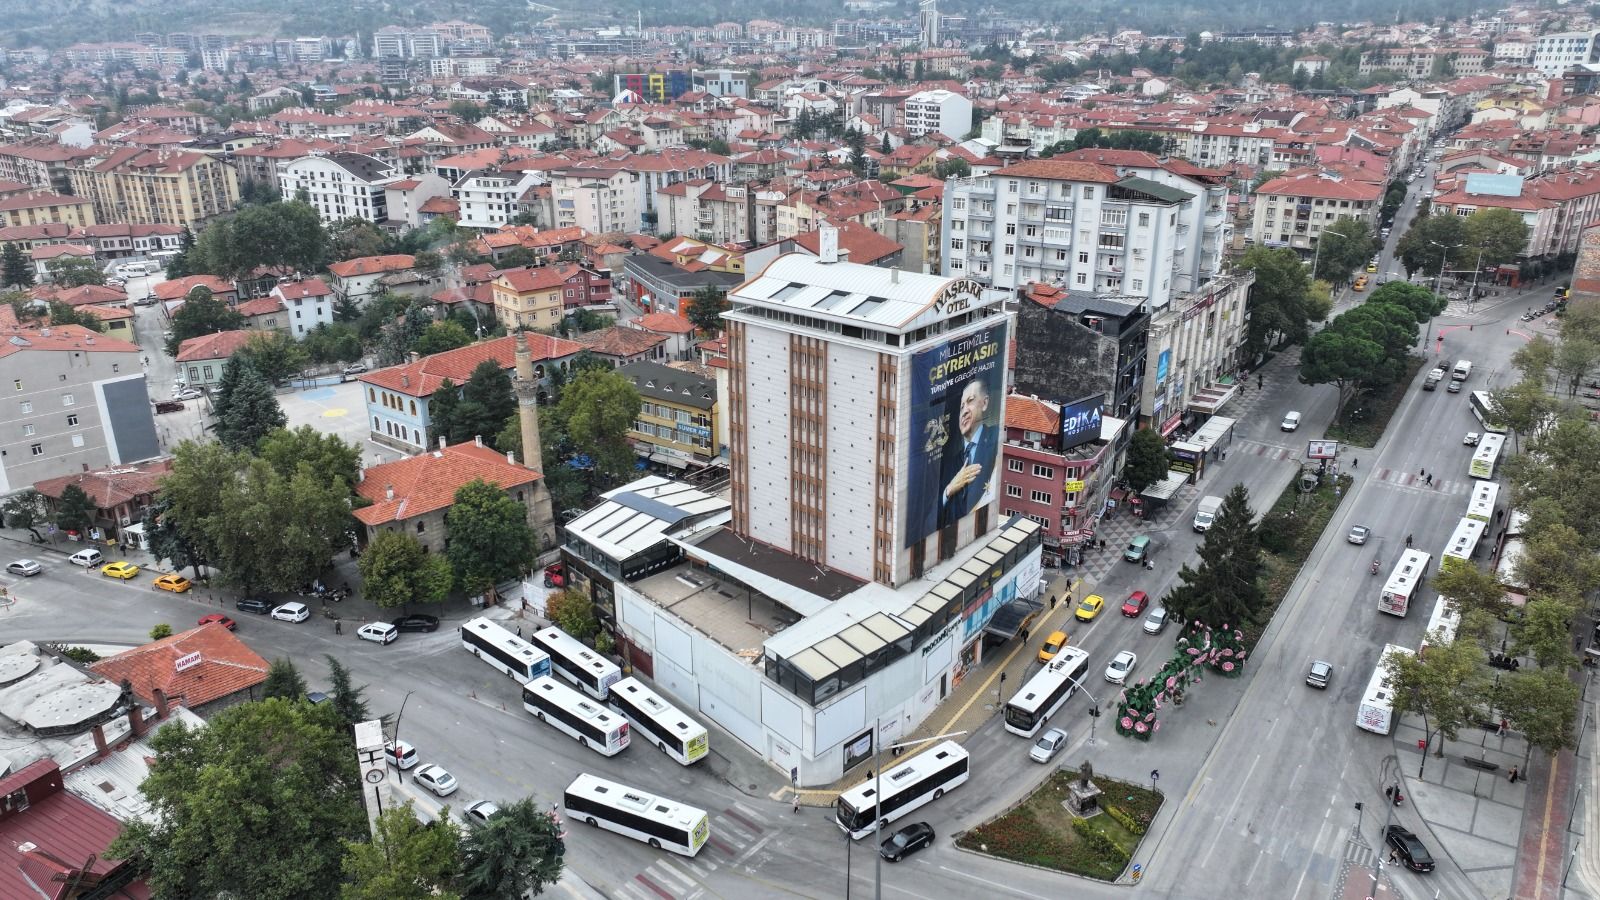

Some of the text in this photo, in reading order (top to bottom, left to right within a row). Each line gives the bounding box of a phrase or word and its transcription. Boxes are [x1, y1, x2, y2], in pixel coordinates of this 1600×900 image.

[947, 298, 970, 314] OTEL
[929, 342, 998, 385] ÇEYREK ASIR
[177, 654, 201, 669] HAMAM
